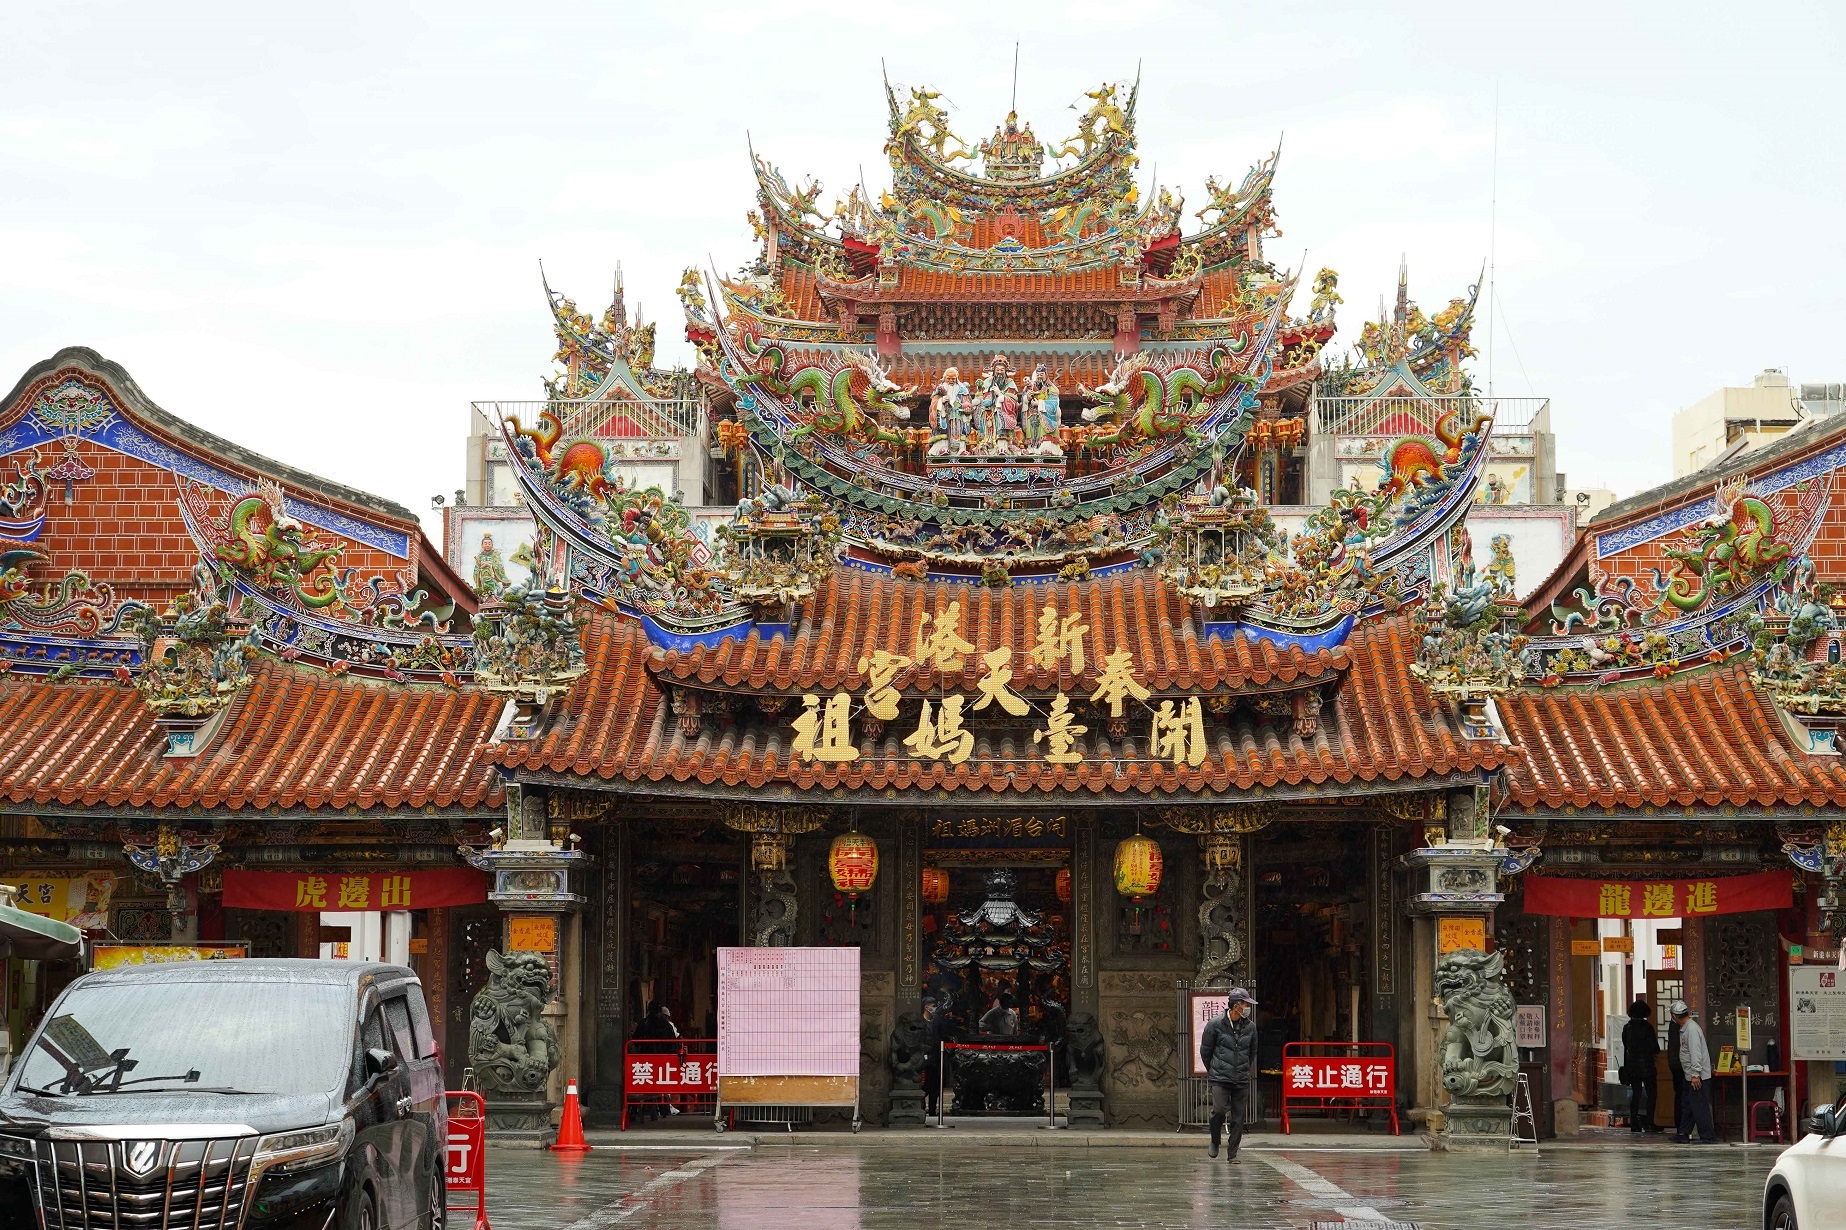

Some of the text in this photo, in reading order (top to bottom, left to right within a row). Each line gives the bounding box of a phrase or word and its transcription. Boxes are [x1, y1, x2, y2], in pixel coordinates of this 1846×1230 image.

[0, 882, 55, 905] 天宮
[295, 875, 412, 909] 虎邊出
[1599, 882, 1719, 917] 龍邊進
[1291, 1064, 1389, 1089] 禁止通行
